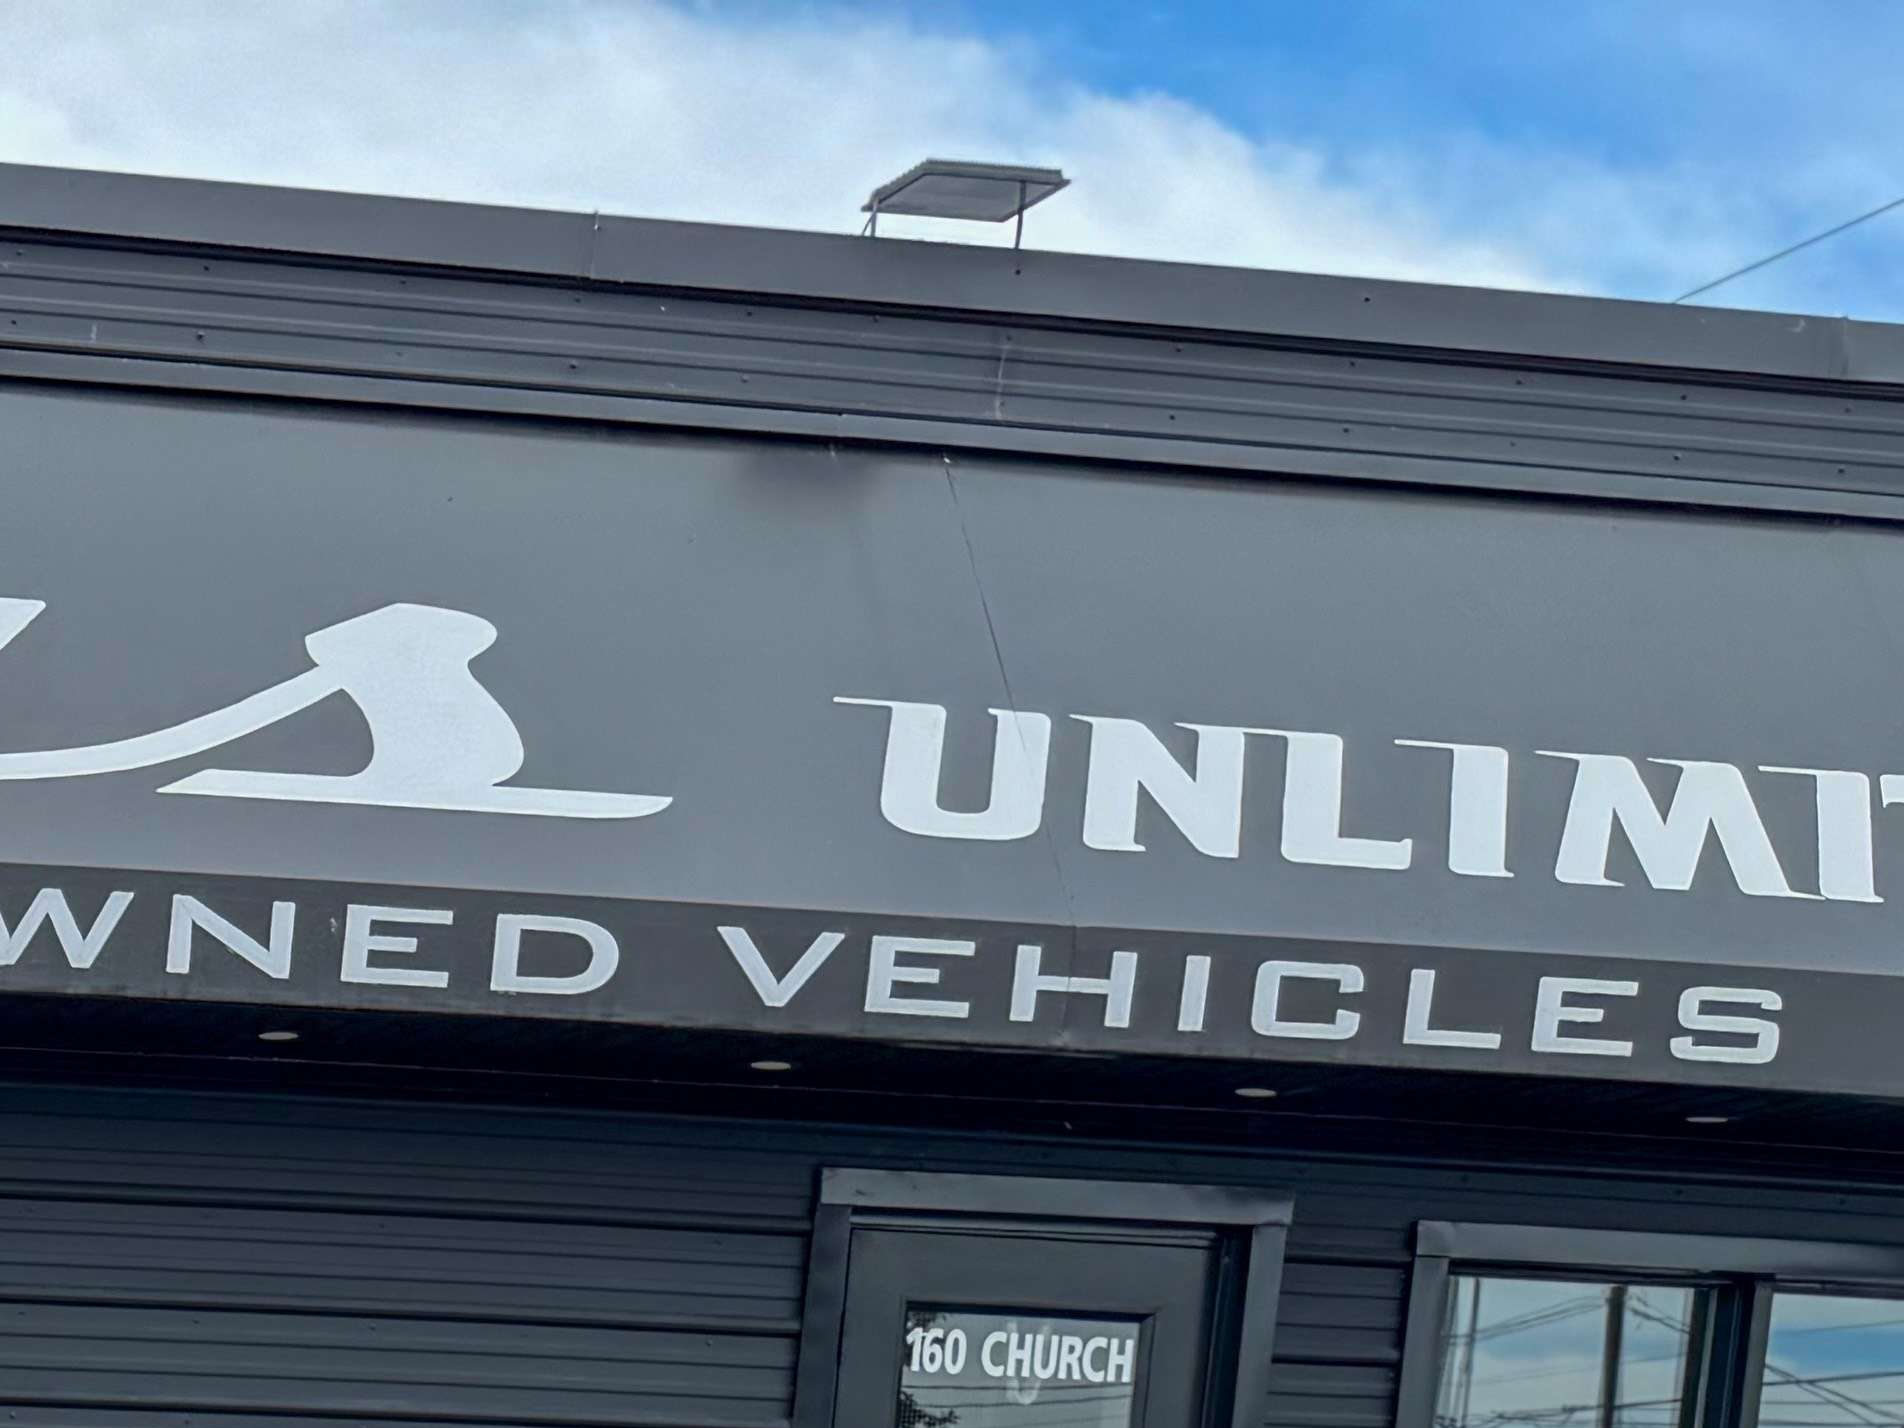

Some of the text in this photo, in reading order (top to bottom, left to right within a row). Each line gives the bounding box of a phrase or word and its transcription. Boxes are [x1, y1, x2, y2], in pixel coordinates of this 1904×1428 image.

[834, 696, 1904, 903] UNLIMI
[716, 925, 1783, 1065] VEHICLES
[906, 1327, 1135, 1383] 160 CHURCH
